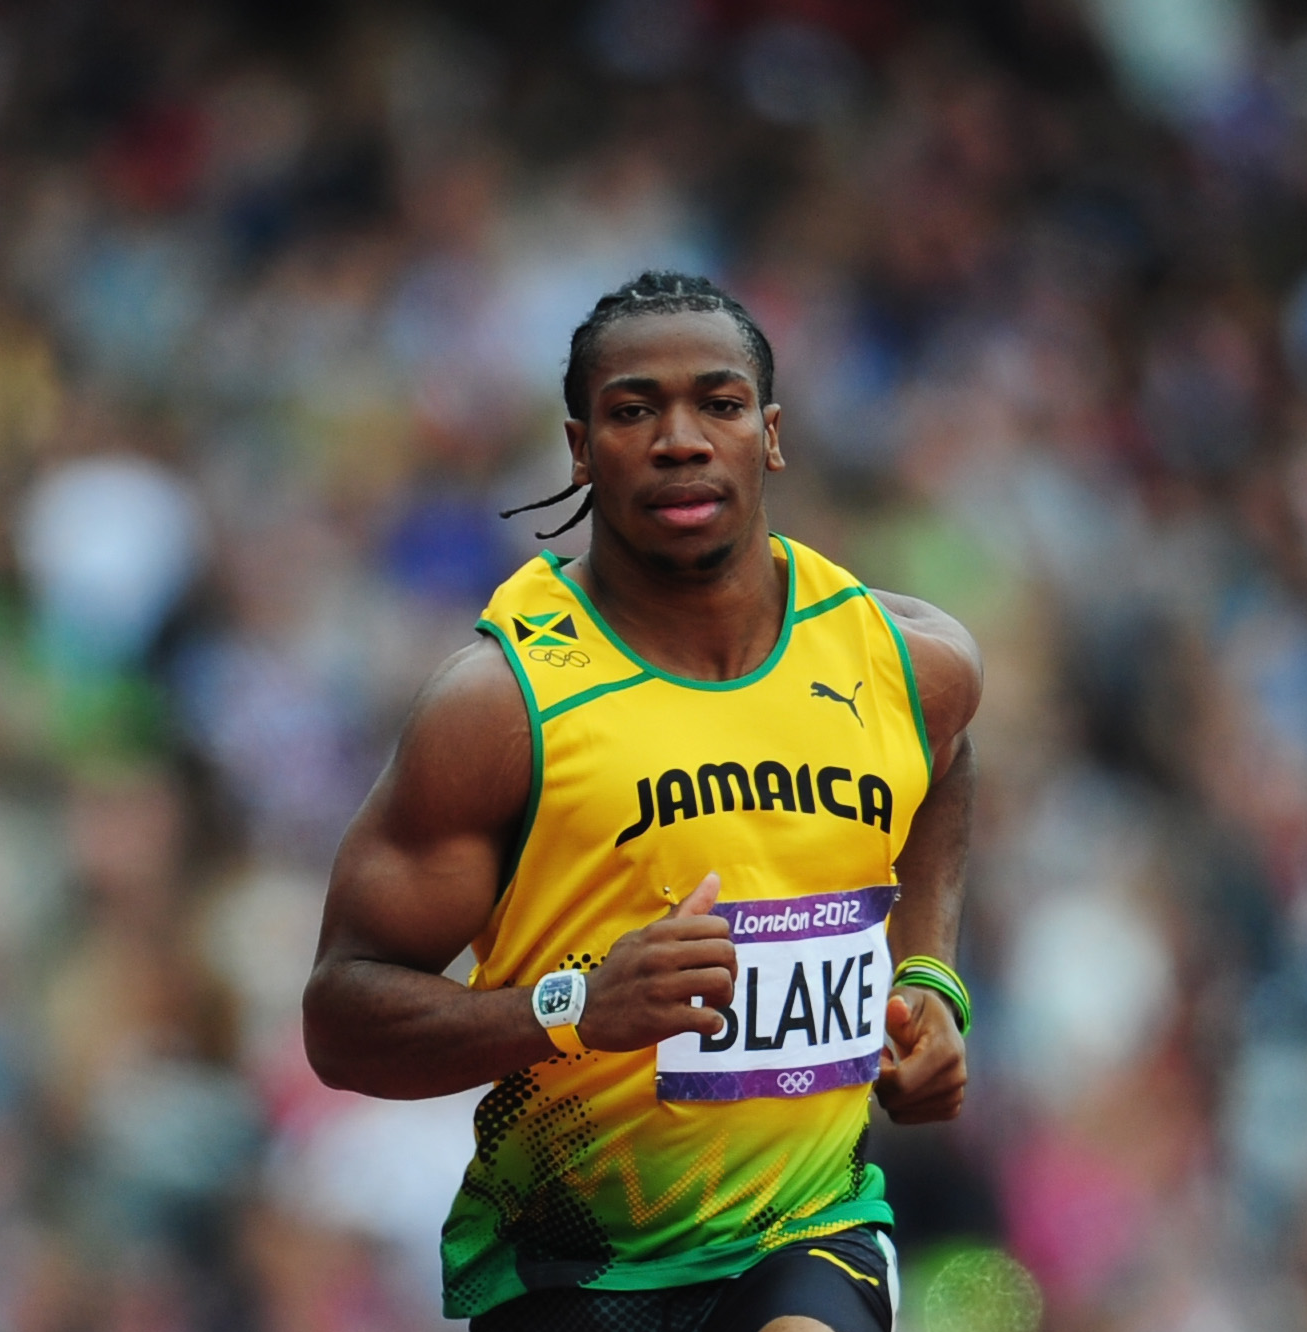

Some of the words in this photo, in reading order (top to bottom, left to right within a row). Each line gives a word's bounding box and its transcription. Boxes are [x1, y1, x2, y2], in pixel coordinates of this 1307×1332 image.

[615, 760, 893, 848] JAMAICA
[733, 906, 810, 935] London
[812, 900, 862, 927] 2012
